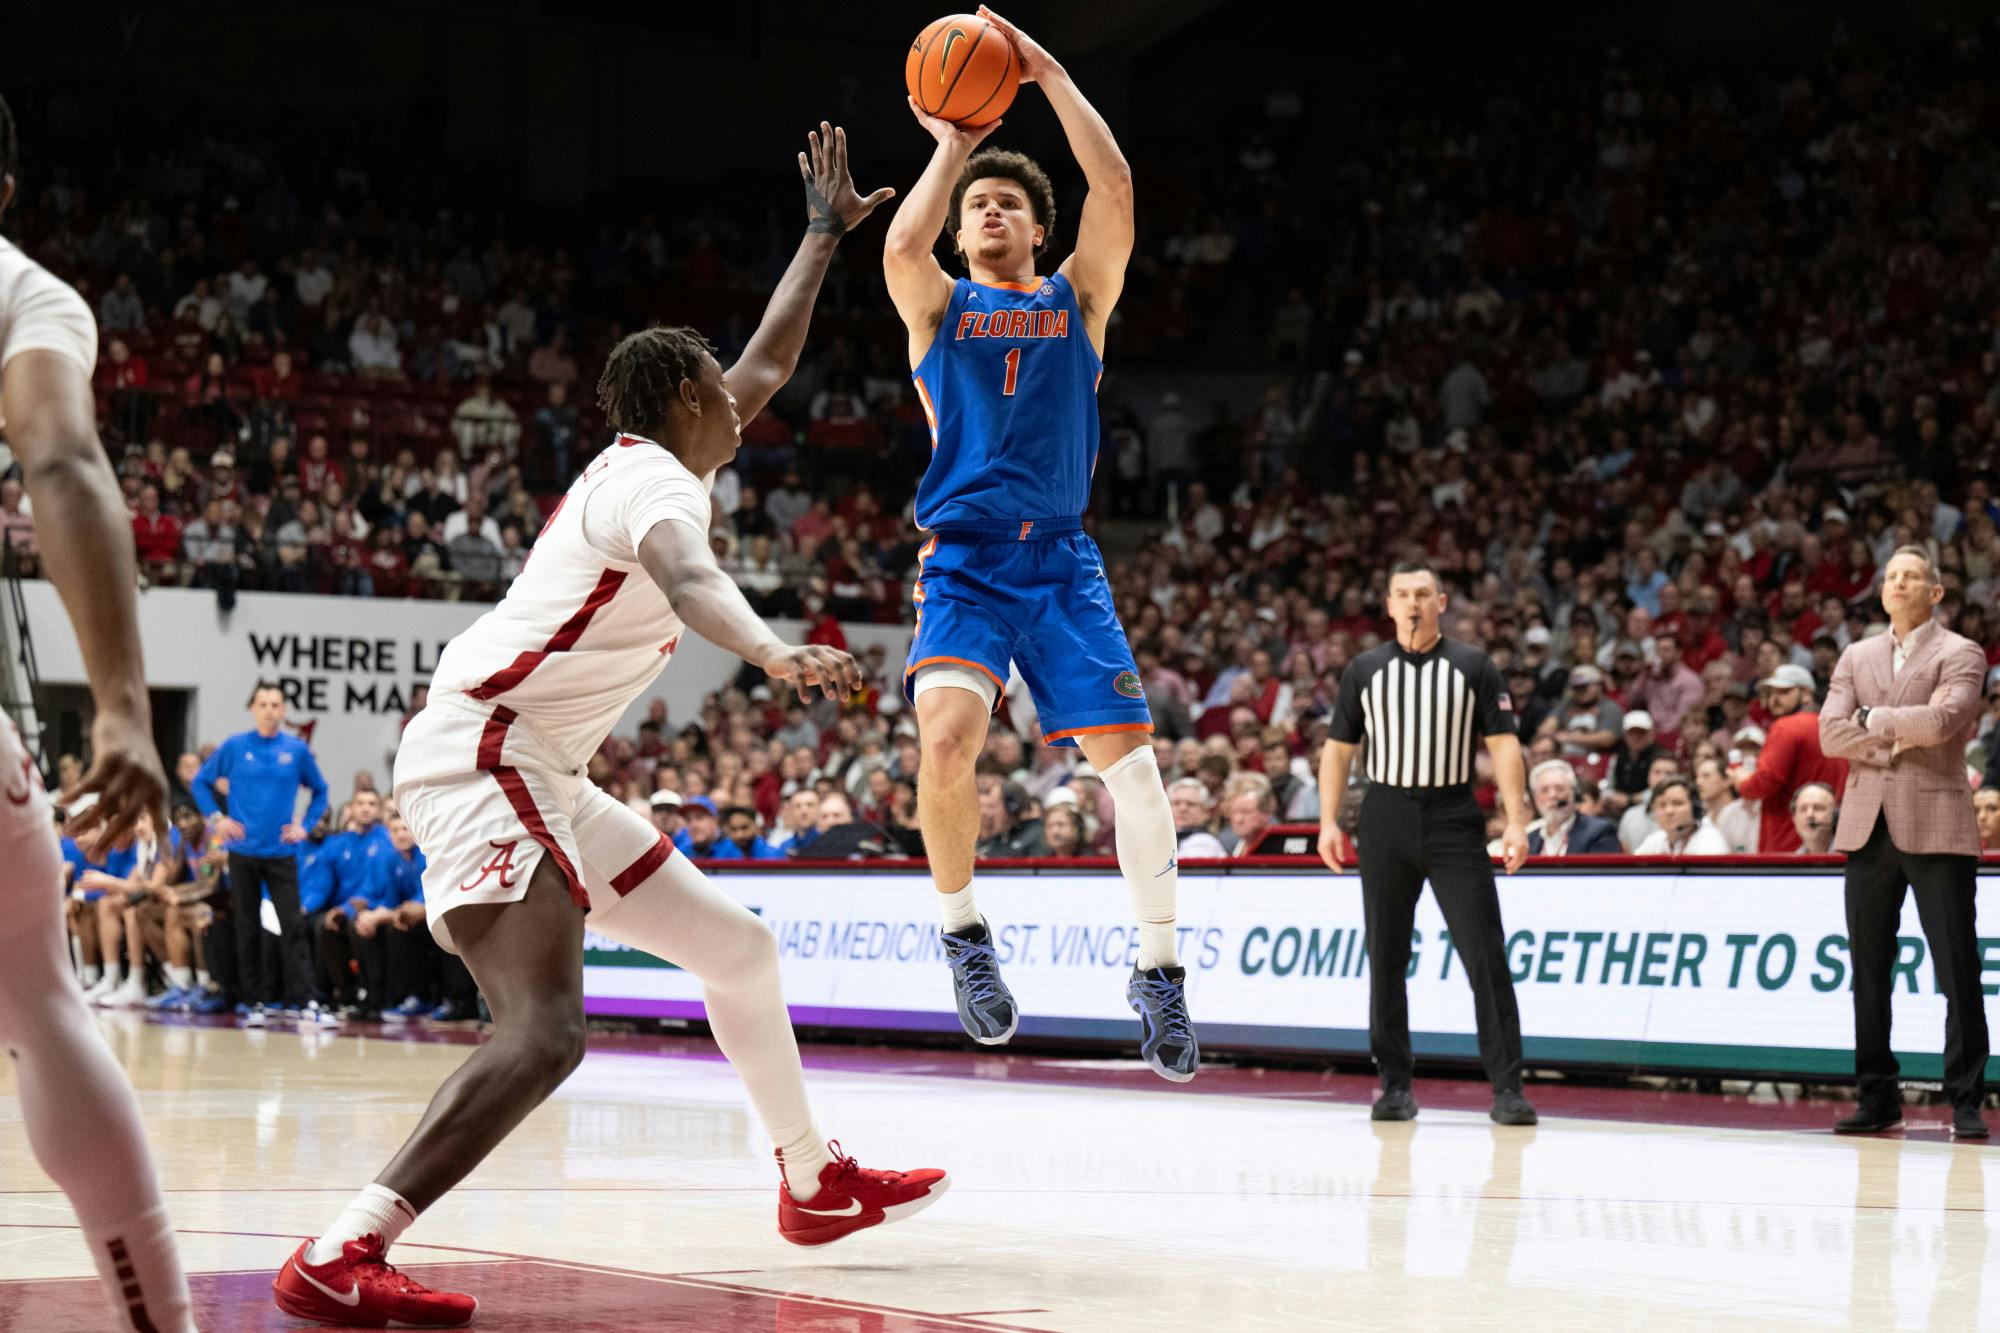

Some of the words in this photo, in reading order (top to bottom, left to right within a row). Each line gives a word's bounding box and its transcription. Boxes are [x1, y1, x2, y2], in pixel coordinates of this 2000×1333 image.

[955, 310, 1068, 340] FLORIDA
[1003, 348, 1020, 395] 1
[1018, 521, 1033, 541] F
[249, 632, 397, 674] WHERE
[460, 840, 518, 892] A
[828, 921, 945, 962] MEDICIN
[1050, 926, 1223, 969] VINCET'S
[1439, 929, 1708, 988] TGETHER
[1726, 933, 1796, 991] TO
[1810, 934, 2000, 996] SRE
